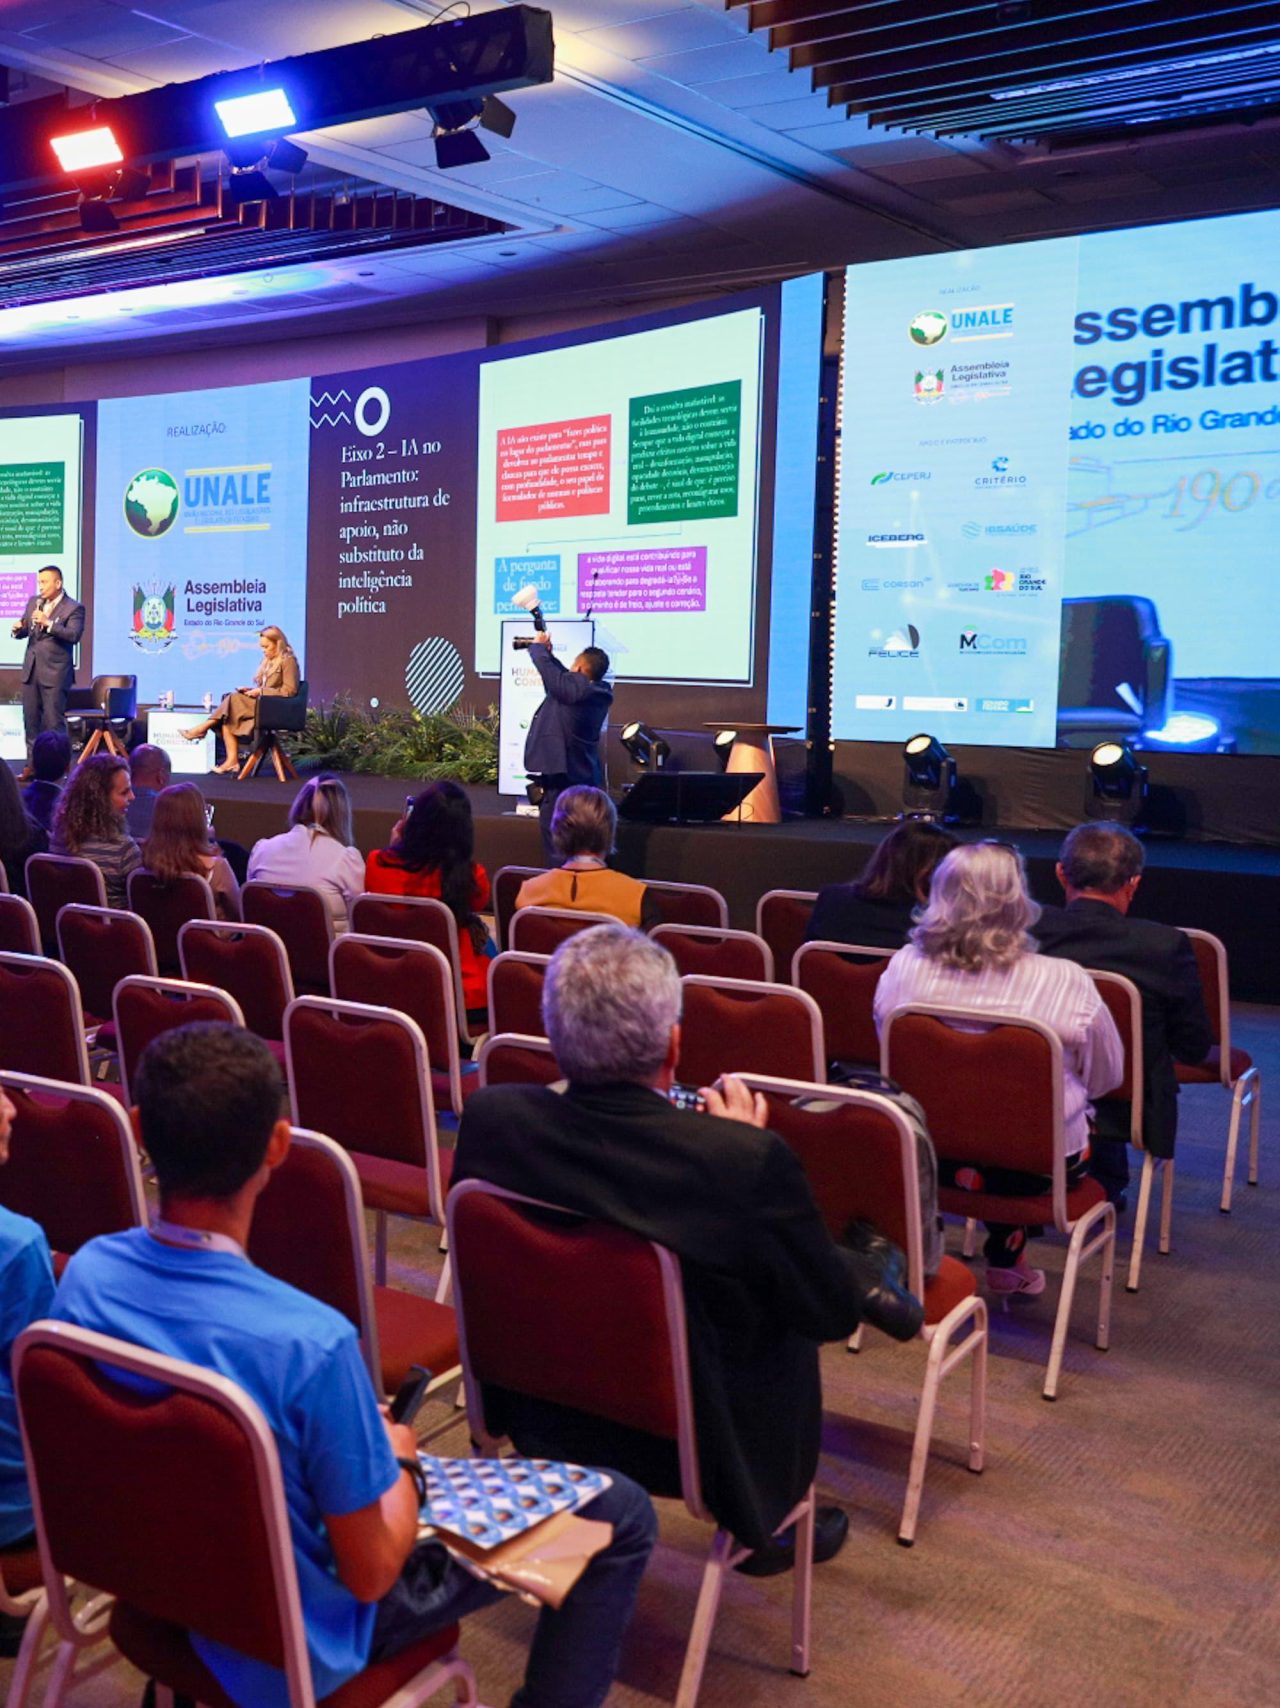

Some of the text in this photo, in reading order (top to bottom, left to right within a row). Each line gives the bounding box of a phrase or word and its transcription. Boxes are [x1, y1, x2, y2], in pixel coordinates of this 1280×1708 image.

[951, 308, 1013, 329] UNALE
[950, 361, 1010, 373] Assembleia
[952, 370, 1007, 382] Legislativa
[1112, 417, 1145, 438] do
[1152, 413, 1192, 435] Rio
[342, 445, 373, 463] Eixo
[376, 442, 385, 460] 2
[401, 438, 419, 457] IA
[422, 441, 441, 455] no
[341, 469, 420, 488] Parlamento:
[893, 471, 932, 481] CEPERJ
[975, 473, 1027, 485] CRITÉRIO
[184, 471, 271, 508] UNALE
[340, 488, 450, 513] infraestrutura de
[1161, 467, 1261, 532] 190
[339, 519, 408, 544] apoio, não
[868, 533, 925, 542] ICEBERG
[339, 543, 425, 564] substituto da
[498, 559, 557, 577] A pergunta
[184, 579, 267, 595] Assembleia
[338, 569, 413, 593] inteligência
[503, 576, 516, 592] de
[187, 597, 262, 616] Legislativa
[338, 596, 386, 619] política
[960, 633, 1027, 650] MCom
[868, 650, 919, 658] FELICE
